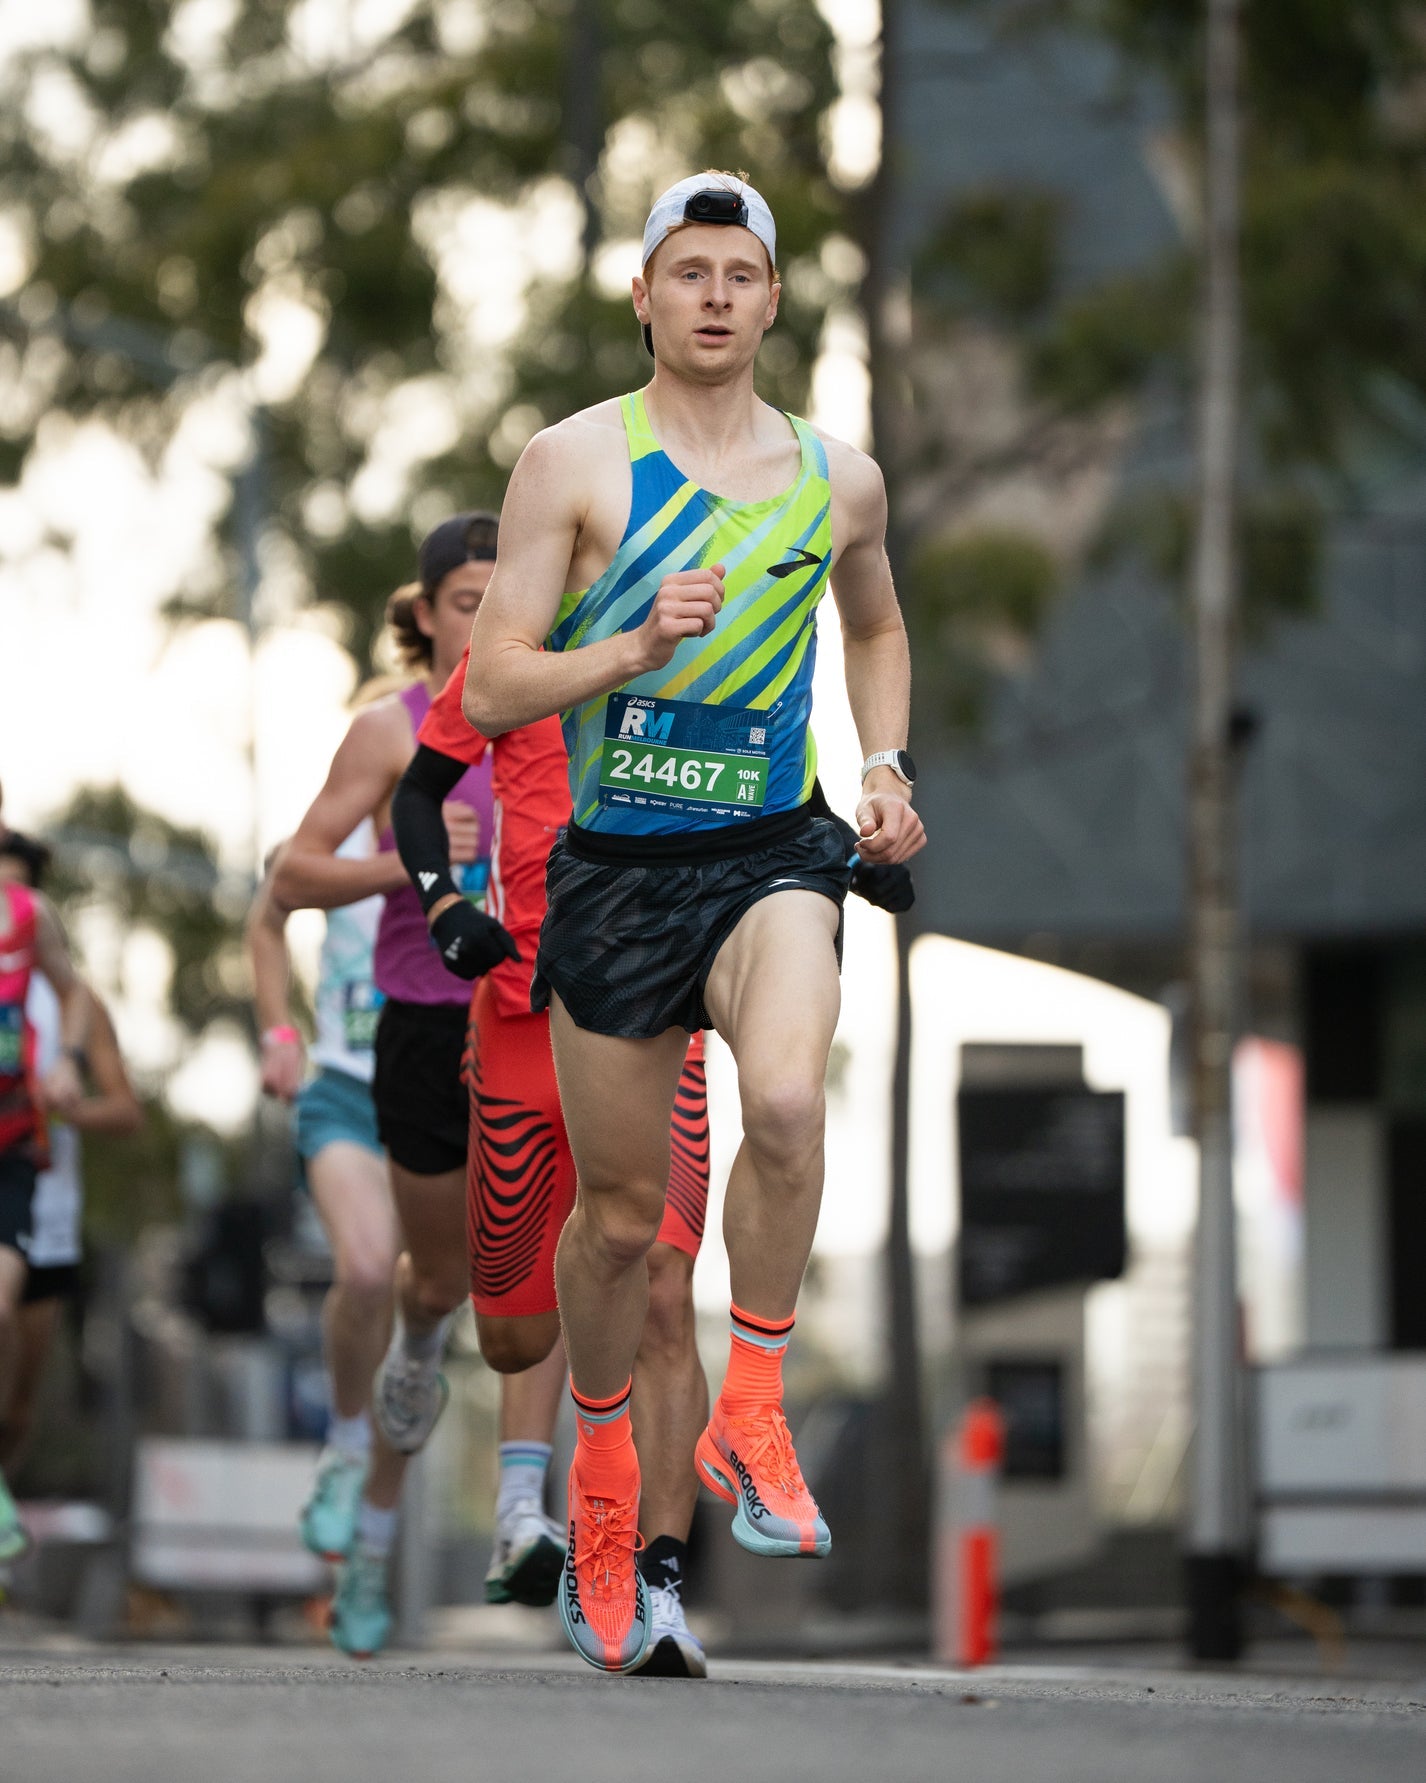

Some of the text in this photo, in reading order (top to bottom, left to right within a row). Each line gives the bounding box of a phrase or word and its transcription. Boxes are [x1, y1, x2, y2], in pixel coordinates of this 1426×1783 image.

[620, 706, 676, 740] RM
[609, 749, 726, 792] 24467
[737, 769, 760, 781] 10K
[737, 783, 747, 800] A
[729, 1450, 771, 1520] BROOKS
[565, 1519, 586, 1625] BROOKS
